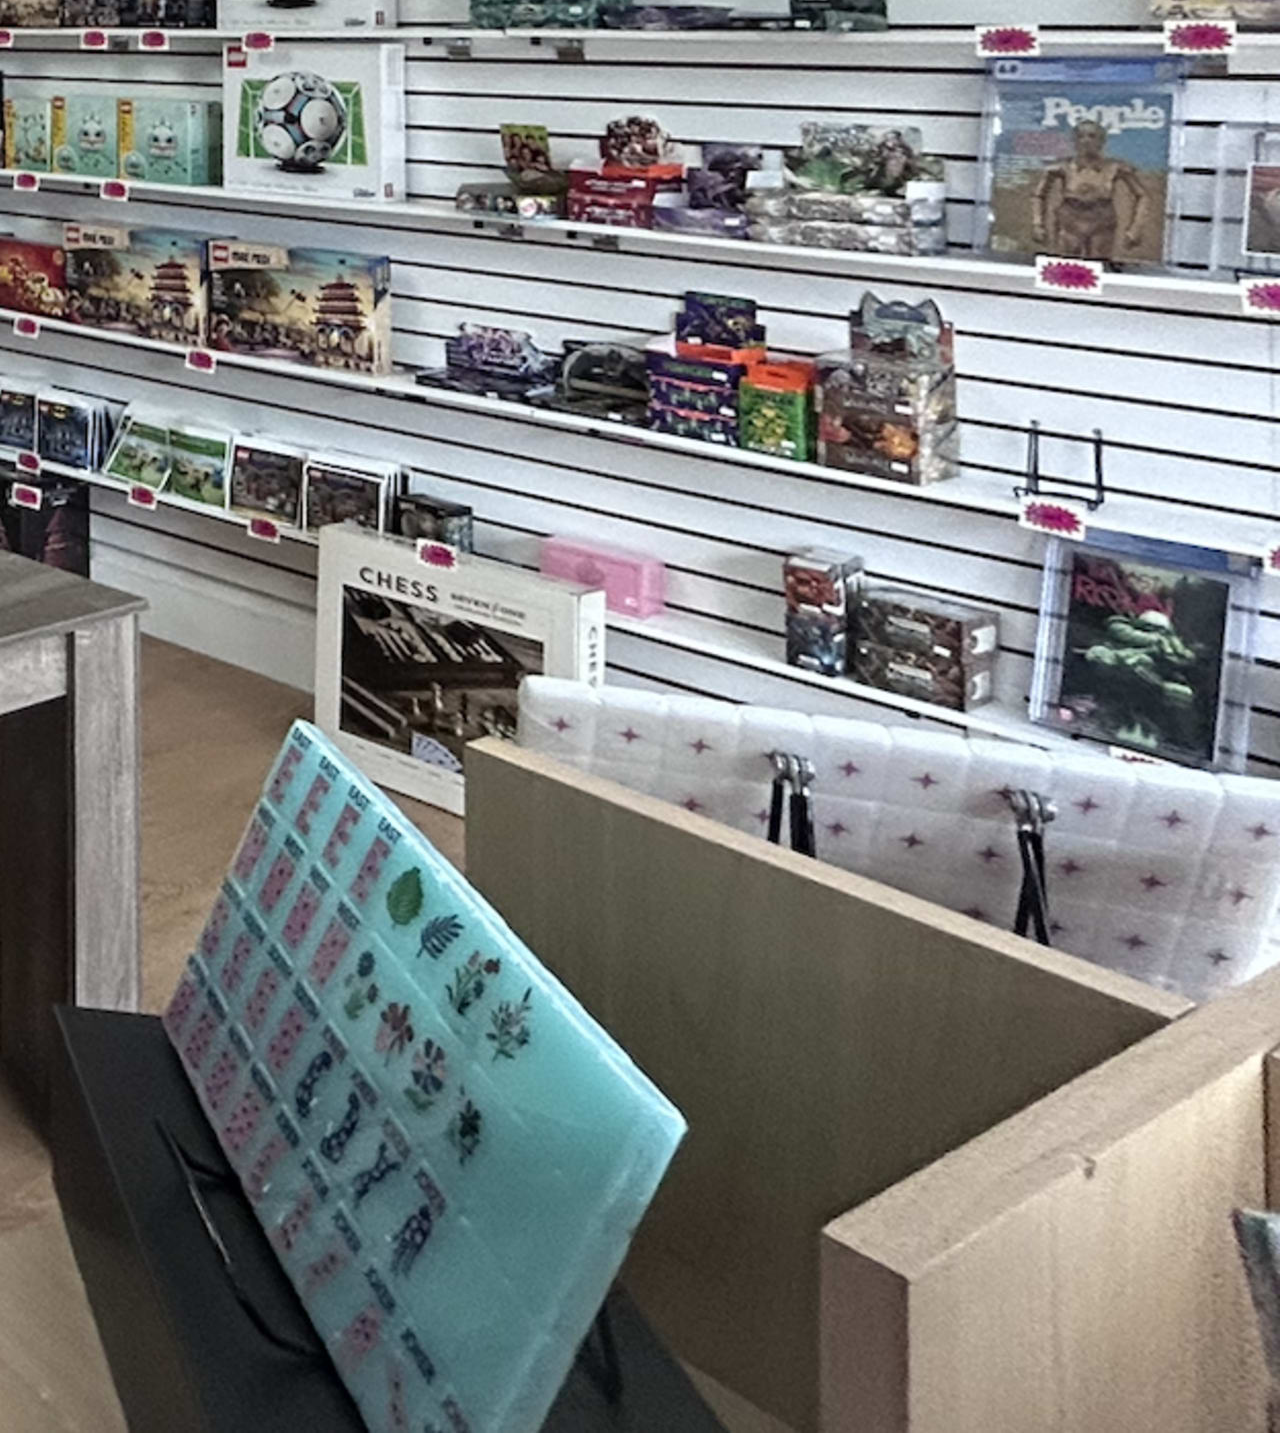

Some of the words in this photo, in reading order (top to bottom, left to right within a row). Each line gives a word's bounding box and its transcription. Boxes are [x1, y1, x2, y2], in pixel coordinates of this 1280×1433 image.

[1042, 97, 1165, 134] People
[359, 566, 438, 603] CHESS
[292, 727, 313, 750] EAST
[319, 756, 340, 781] EAST
[348, 785, 371, 811] EAST
[378, 817, 402, 844] EAST
